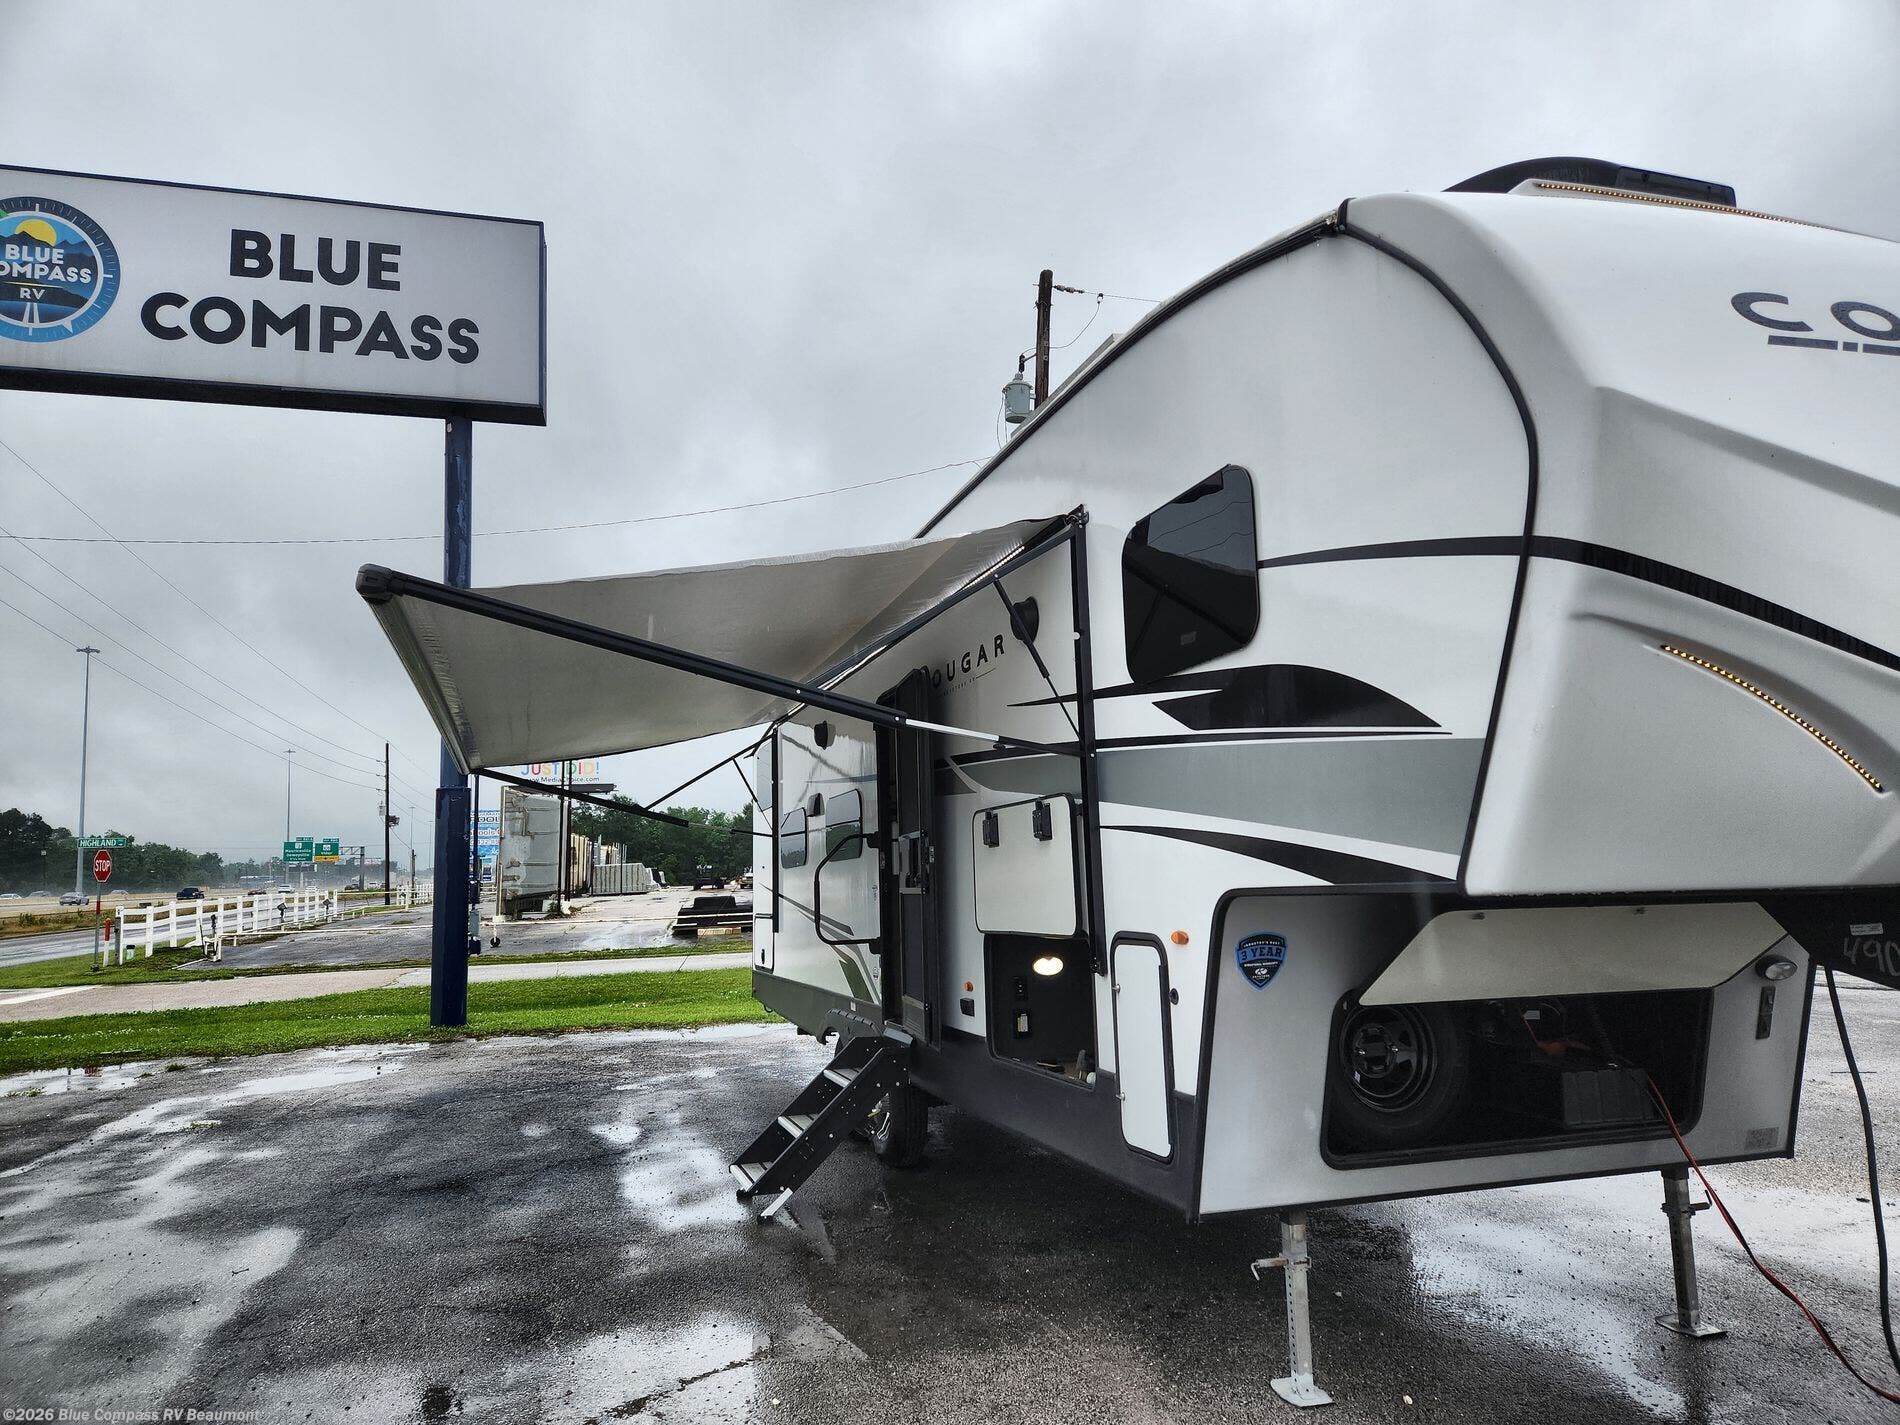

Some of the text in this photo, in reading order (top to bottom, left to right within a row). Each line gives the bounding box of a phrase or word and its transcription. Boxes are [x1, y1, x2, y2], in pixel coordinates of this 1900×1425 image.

[5, 244, 64, 264] BLUE
[229, 228, 401, 291] BLUE
[0, 262, 91, 283] OMPASS
[20, 287, 45, 300] RV
[1730, 291, 1900, 341] CO
[140, 291, 480, 365] COMPASS
[932, 634, 1004, 688] OUGAR
[521, 761, 600, 776] JUST DID!
[80, 839, 116, 847] HIGHLAND
[95, 860, 110, 871] STOP
[1241, 946, 1282, 961] 3 YEAR
